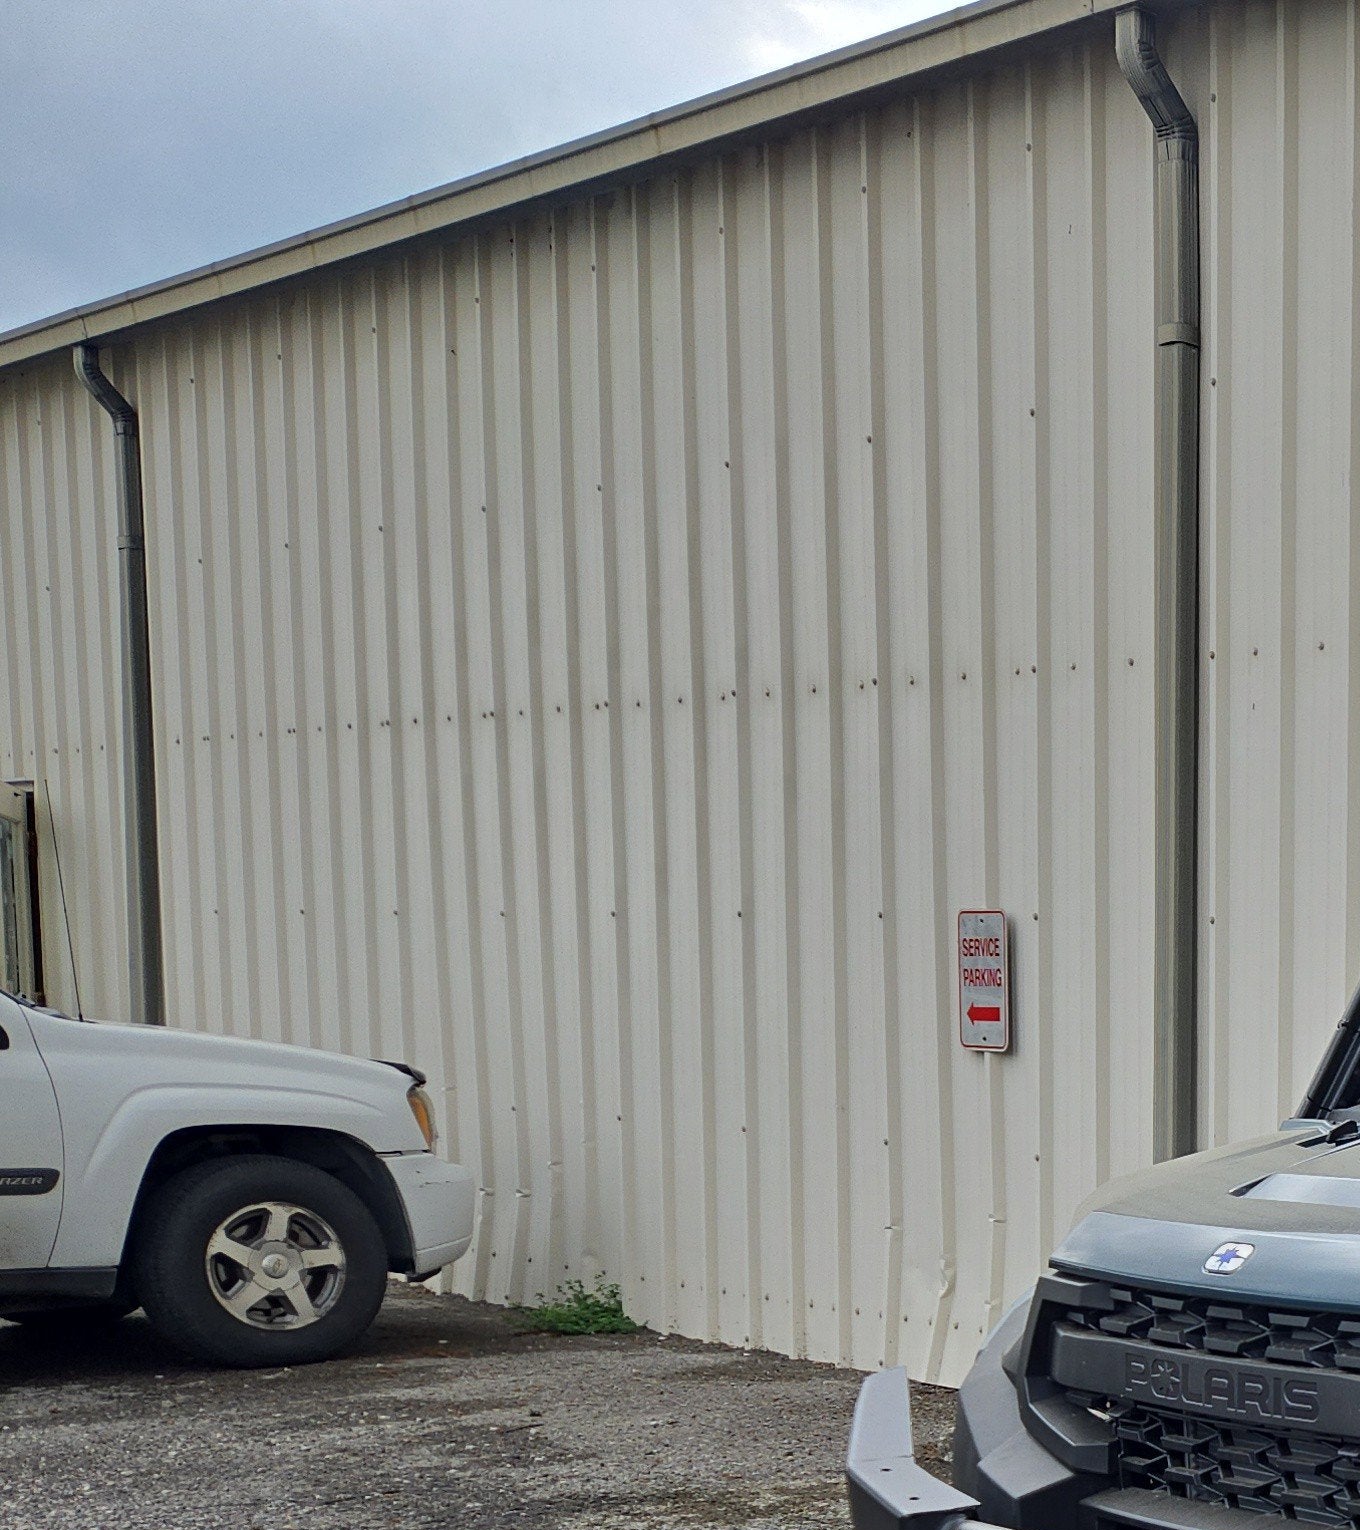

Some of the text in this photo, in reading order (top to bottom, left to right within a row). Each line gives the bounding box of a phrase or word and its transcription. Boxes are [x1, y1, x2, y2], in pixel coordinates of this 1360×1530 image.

[962, 938, 1000, 957] SERVICE
[963, 968, 1002, 987] PARKING
[1124, 1352, 1320, 1423] POLARIS
